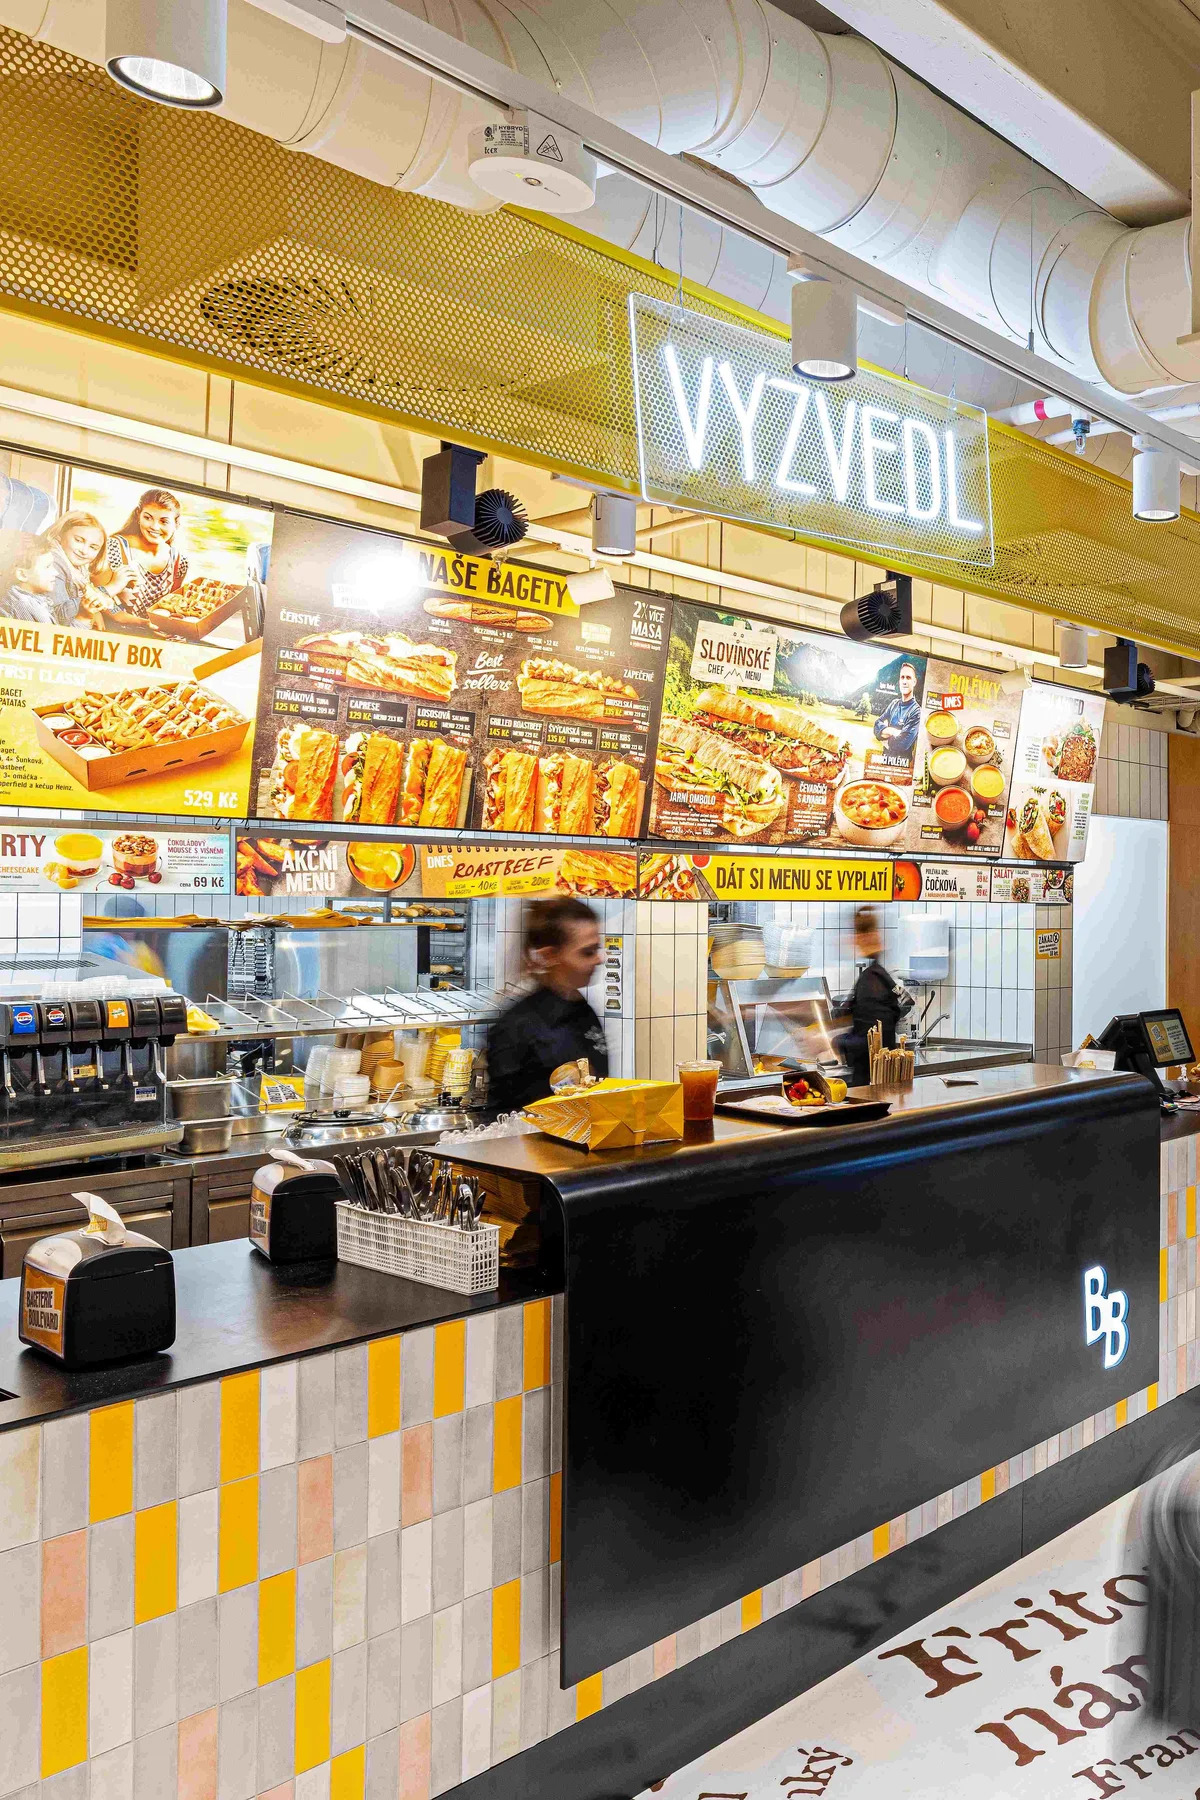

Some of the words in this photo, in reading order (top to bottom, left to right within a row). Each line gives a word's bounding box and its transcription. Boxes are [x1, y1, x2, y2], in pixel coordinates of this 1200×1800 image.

[661, 345, 984, 532] VYZVEDL
[419, 551, 478, 591] NAŠE
[487, 567, 568, 608] BAGETY
[279, 608, 321, 626] ČERSTVÉ
[631, 620, 662, 640] MASA
[52, 633, 120, 662] FAMILY
[127, 645, 163, 669] BOX
[280, 650, 309, 662] CAESAR
[474, 651, 504, 669] Best
[700, 638, 770, 670] SLOVINSKÉ
[707, 663, 725, 675] CHEF
[745, 669, 762, 682] MENU
[462, 674, 512, 691] sellers
[944, 696, 962, 708] DNES
[183, 789, 213, 808] 529
[218, 791, 239, 809] Kč
[689, 793, 716, 805] OMBOLO
[1, 834, 46, 857] RTY
[281, 845, 338, 872] AKČNÍ
[427, 855, 454, 869] DNES
[453, 855, 554, 879] ROASTBEEF
[193, 877, 207, 888] 69
[211, 877, 224, 888] Kč
[286, 872, 336, 893] MENU
[716, 862, 745, 889] DÁT
[750, 868, 764, 889] SI
[768, 869, 810, 890] MENU
[816, 870, 832, 890] SE
[837, 867, 887, 891] VYPLATÍ
[993, 867, 1014, 879] SALÁTY
[925, 876, 957, 891] ČOČKOVÁ
[1038, 932, 1053, 944] ZÁKAZ
[27, 1291, 53, 1308] BAGETERIE
[29, 1309, 58, 1330] BOULEVARD
